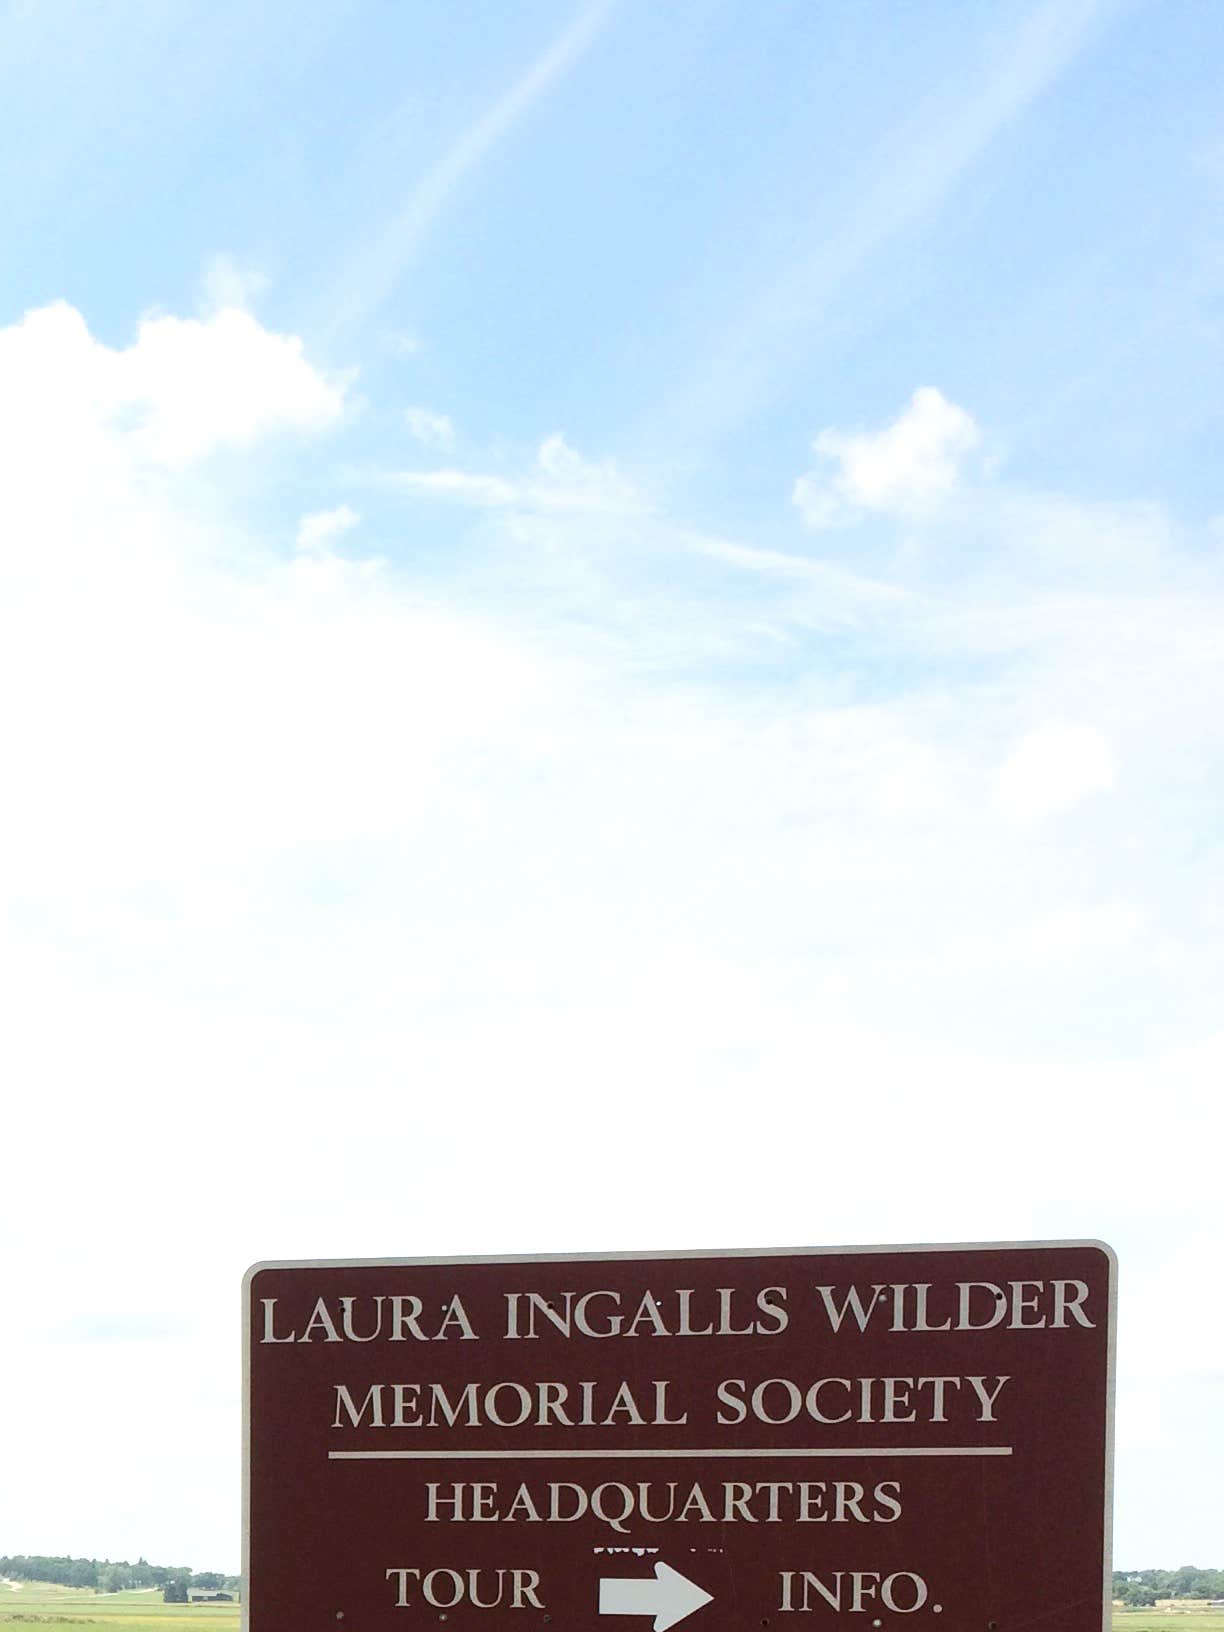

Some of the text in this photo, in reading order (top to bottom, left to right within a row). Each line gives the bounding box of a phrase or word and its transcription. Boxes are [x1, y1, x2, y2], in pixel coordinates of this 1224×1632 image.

[260, 1279, 1097, 1343] LAURA INGALLS WILDER
[331, 1376, 1011, 1428] MEMORIAL SOCIETY
[424, 1481, 902, 1534] HEADQUARTERS
[385, 1568, 943, 1613] TOUR INFO.
